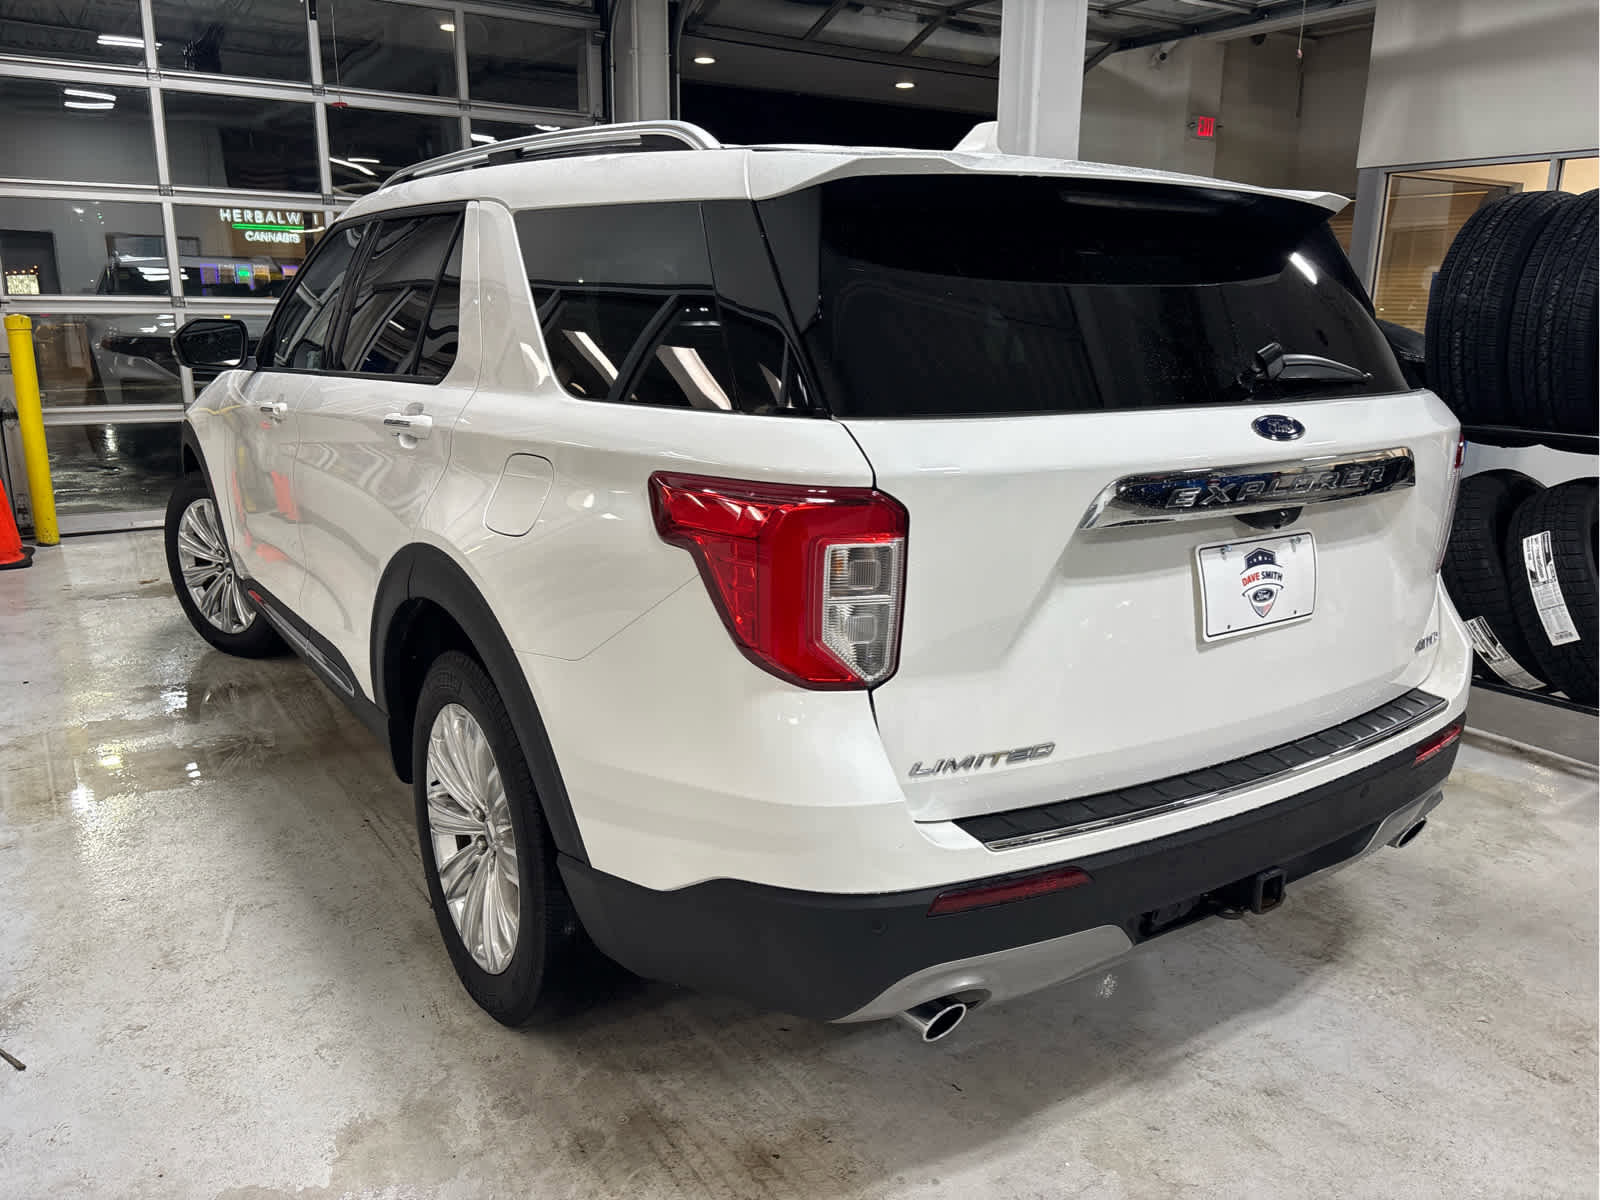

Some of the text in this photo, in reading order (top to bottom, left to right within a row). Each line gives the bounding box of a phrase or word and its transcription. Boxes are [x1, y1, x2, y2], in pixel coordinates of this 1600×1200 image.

[1197, 116, 1215, 137] EXIT
[244, 230, 301, 243] CANNABIS
[1165, 466, 1385, 508] EXPLORER
[1241, 570, 1283, 587] DAVE SMITH
[908, 742, 1056, 777] LIMITED
